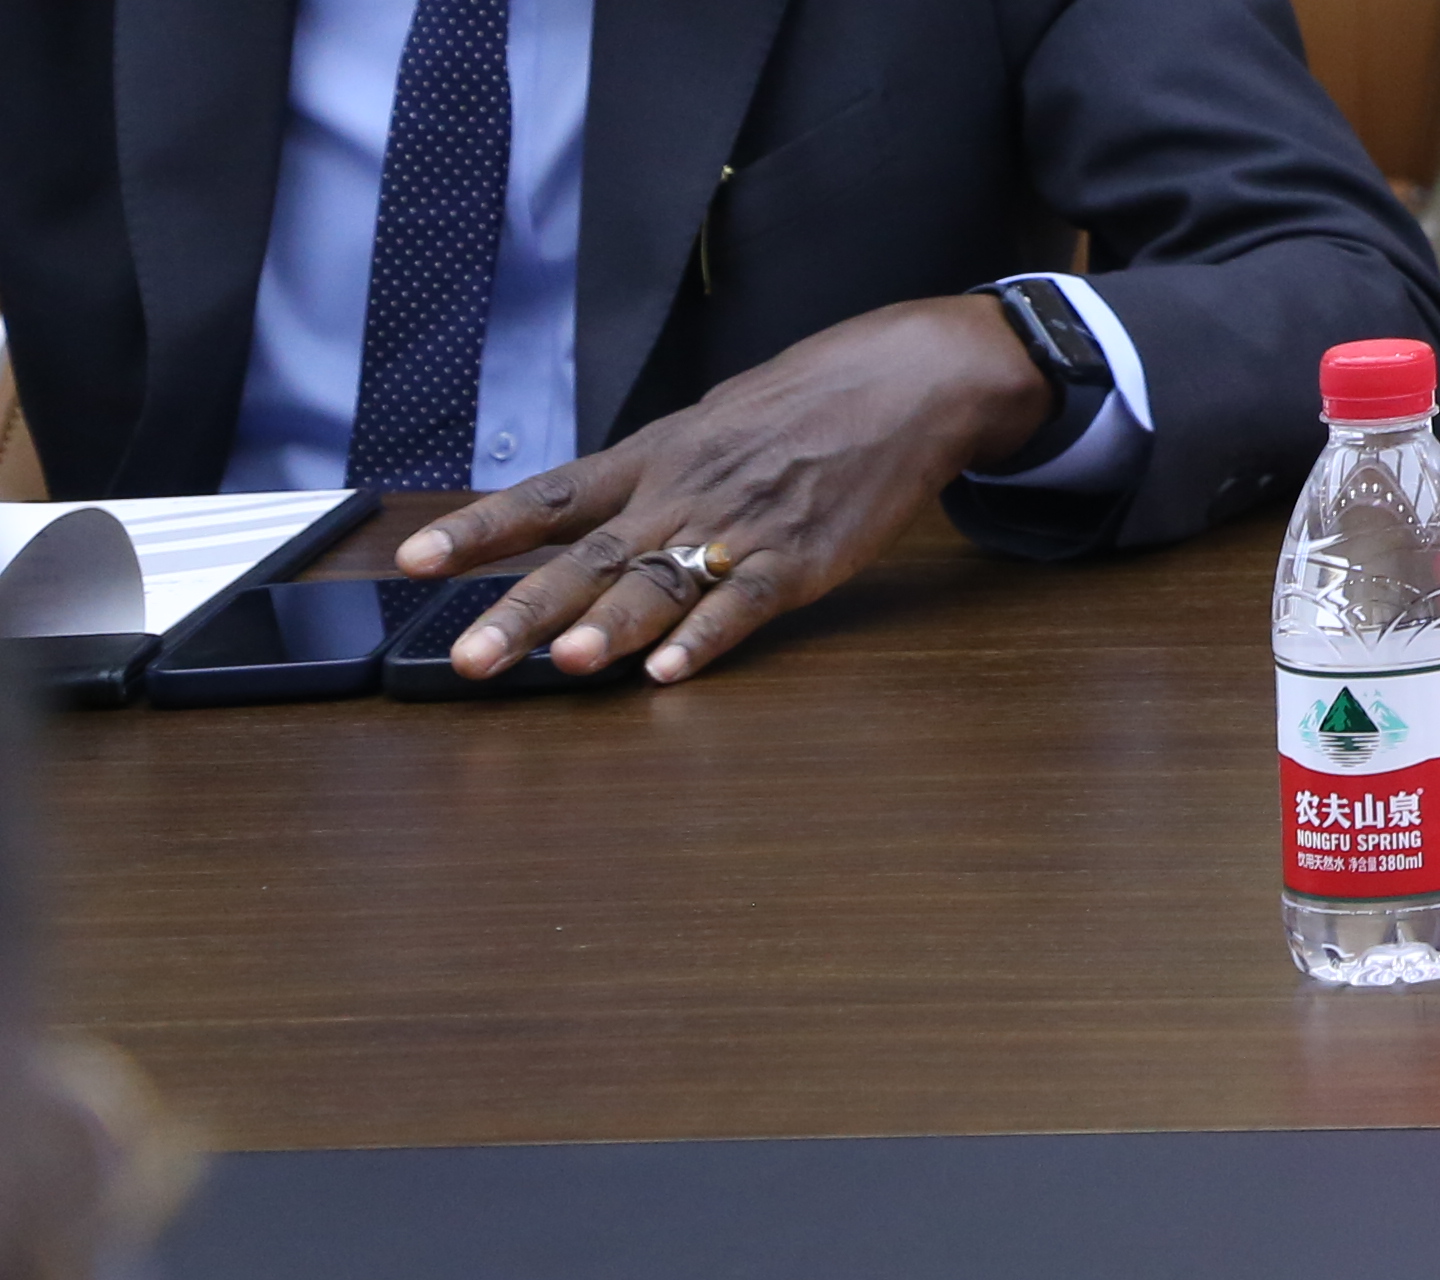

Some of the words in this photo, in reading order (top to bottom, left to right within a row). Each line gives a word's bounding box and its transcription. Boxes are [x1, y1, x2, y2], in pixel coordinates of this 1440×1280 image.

[1296, 790, 1422, 829] 农夫山泉
[1297, 828, 1350, 851] NONGFU
[1357, 830, 1422, 851] SPRING
